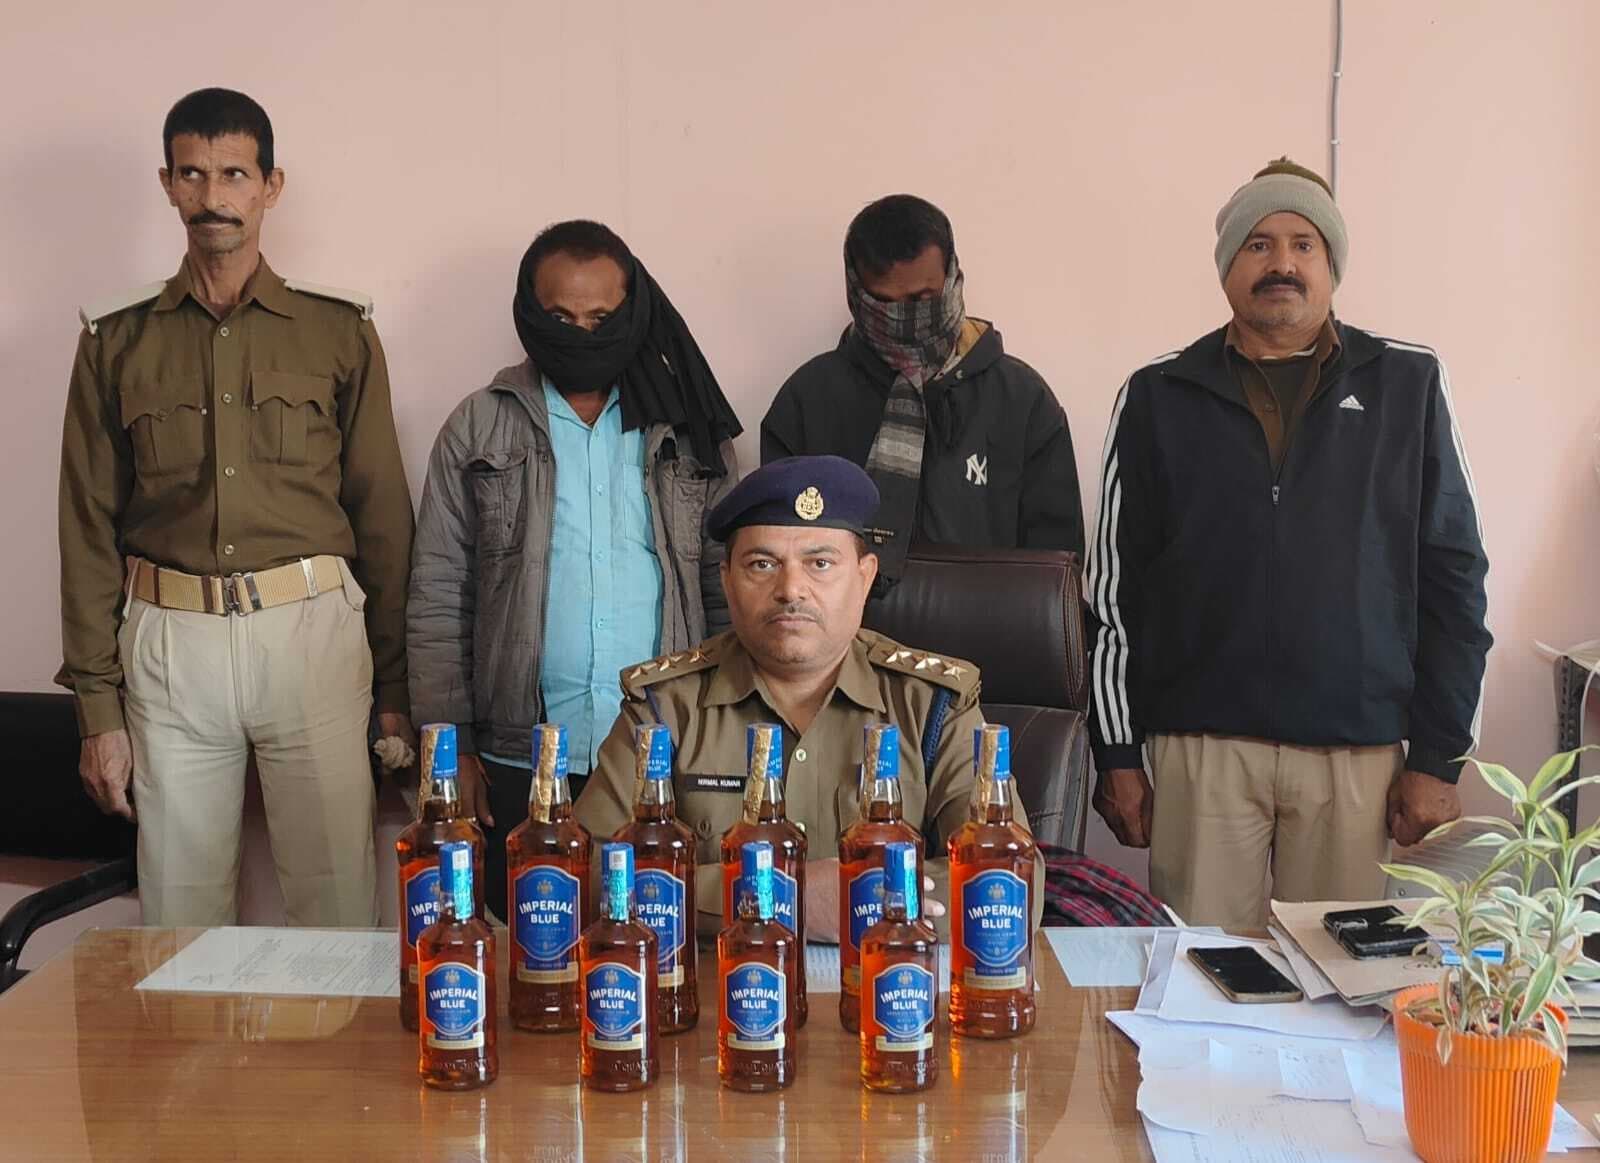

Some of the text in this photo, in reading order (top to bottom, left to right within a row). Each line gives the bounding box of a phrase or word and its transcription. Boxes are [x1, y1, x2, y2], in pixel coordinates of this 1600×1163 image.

[720, 779, 741, 788] KUMAR
[411, 902, 440, 917] IMPE
[518, 900, 574, 915] IMPERIAL
[638, 903, 680, 918] PERIAL
[854, 903, 882, 918] IMPE
[968, 904, 1024, 920] IMPERIAL
[530, 914, 560, 924] BLUE
[981, 918, 1012, 929] BLUE
[429, 987, 478, 1001] IMPERIAL
[590, 987, 637, 1002] IMPERIAL
[731, 987, 779, 1001] IMPERIAL
[880, 988, 929, 1003] IMPERIAL
[440, 999, 466, 1009] BLUE
[599, 999, 625, 1010] BLUE
[741, 999, 768, 1009] BLUE
[892, 1000, 918, 1011] BLUE
